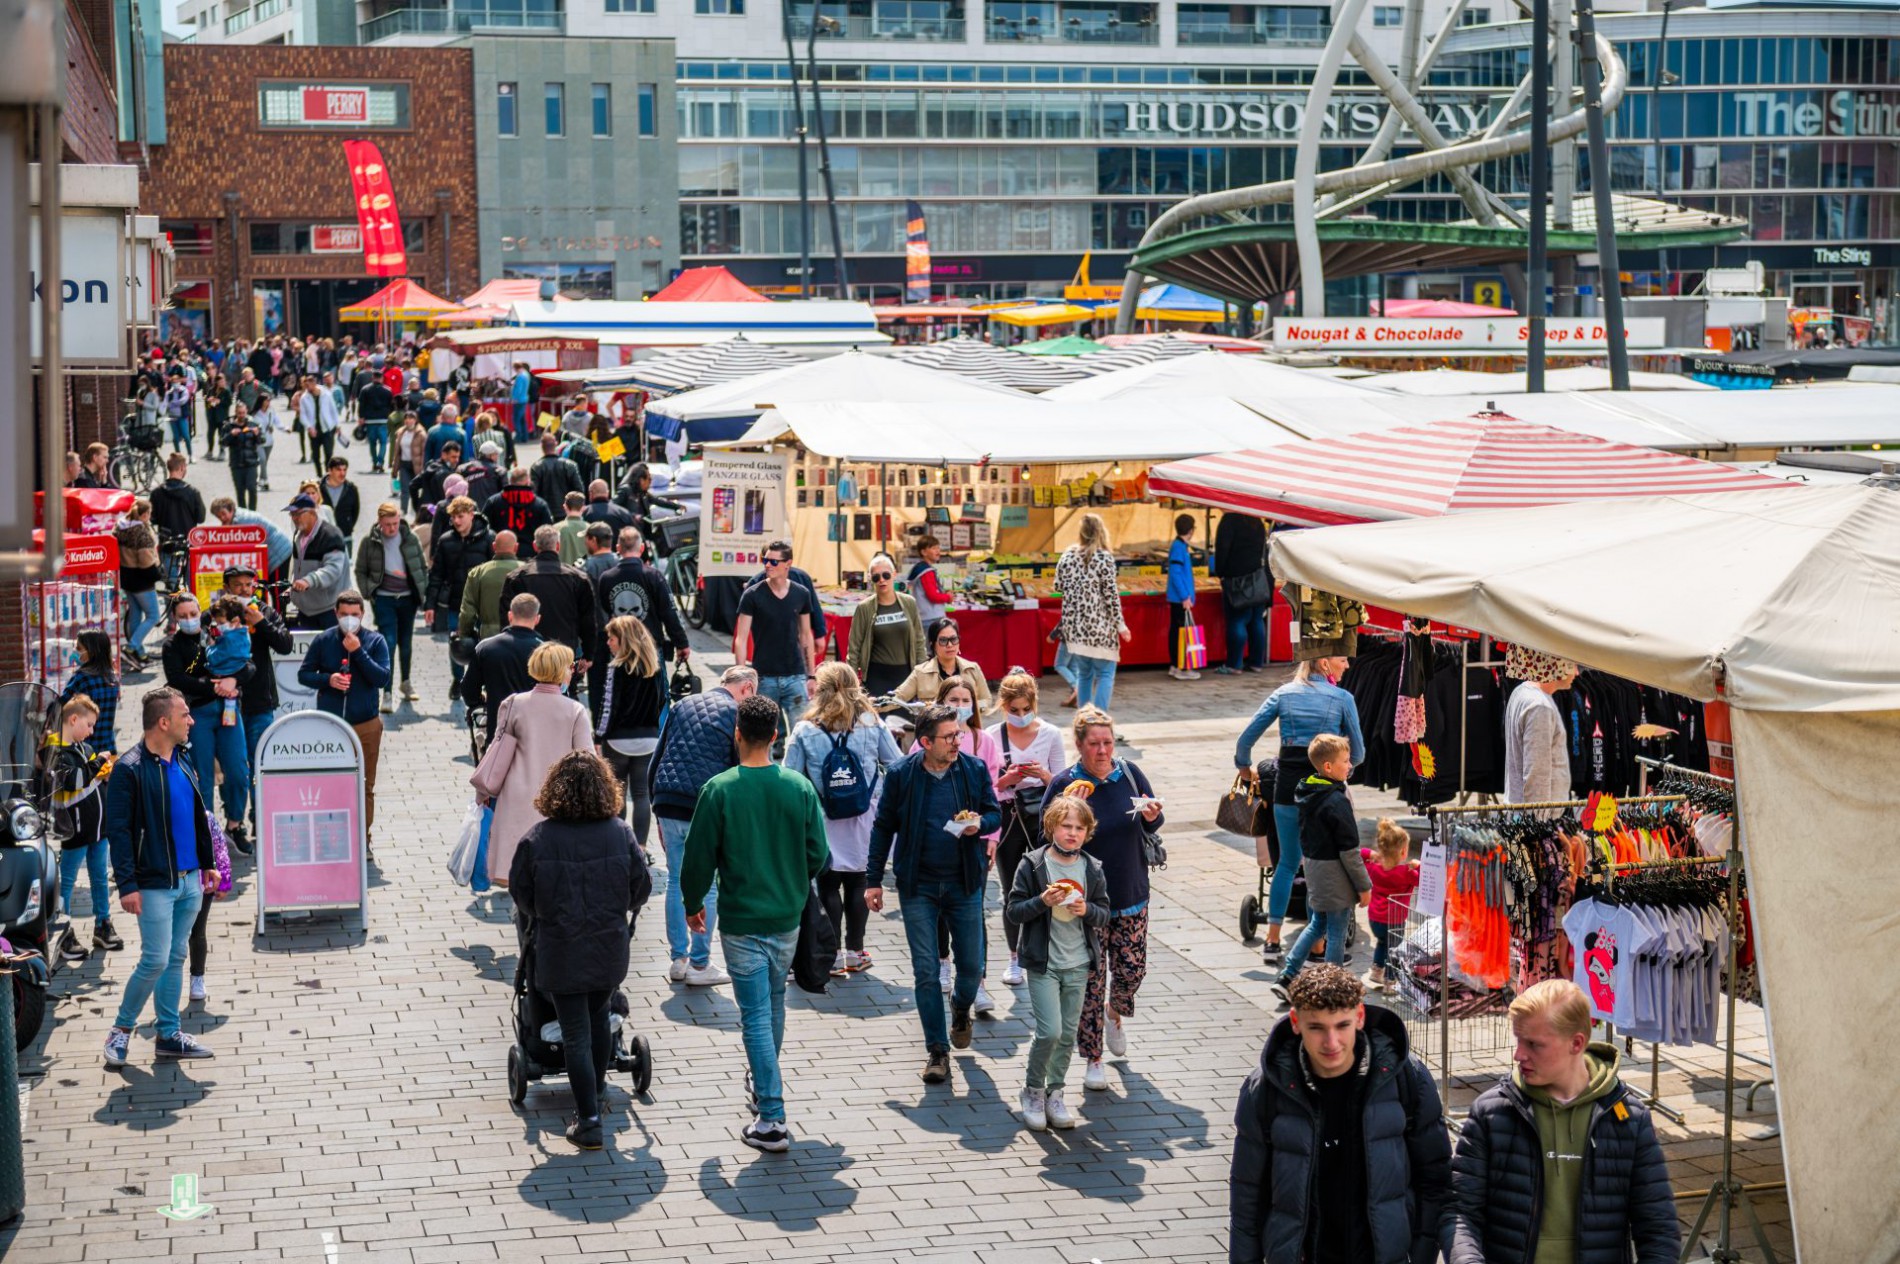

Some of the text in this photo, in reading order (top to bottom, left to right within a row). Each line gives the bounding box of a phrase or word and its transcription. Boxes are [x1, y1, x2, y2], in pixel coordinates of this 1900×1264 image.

[326, 93, 363, 115] PERRY
[1125, 102, 1489, 133] HUDSON'S AY
[1734, 93, 1822, 135] The
[1814, 247, 1871, 266] The Sting
[1481, 287, 1494, 303] 2
[1287, 326, 1463, 343] Nougat & Chocolade
[1518, 327, 1568, 343] Sep
[1573, 327, 1584, 340] &
[477, 341, 585, 354] STROOPWAFELS XXL
[708, 460, 782, 470] Tempered Glass
[708, 471, 782, 481] PANZER GLASS
[208, 530, 261, 542] Kruidvat
[70, 550, 104, 562] Kruidvat
[200, 552, 257, 570] ACTIE!
[273, 741, 345, 755] PANDORA
